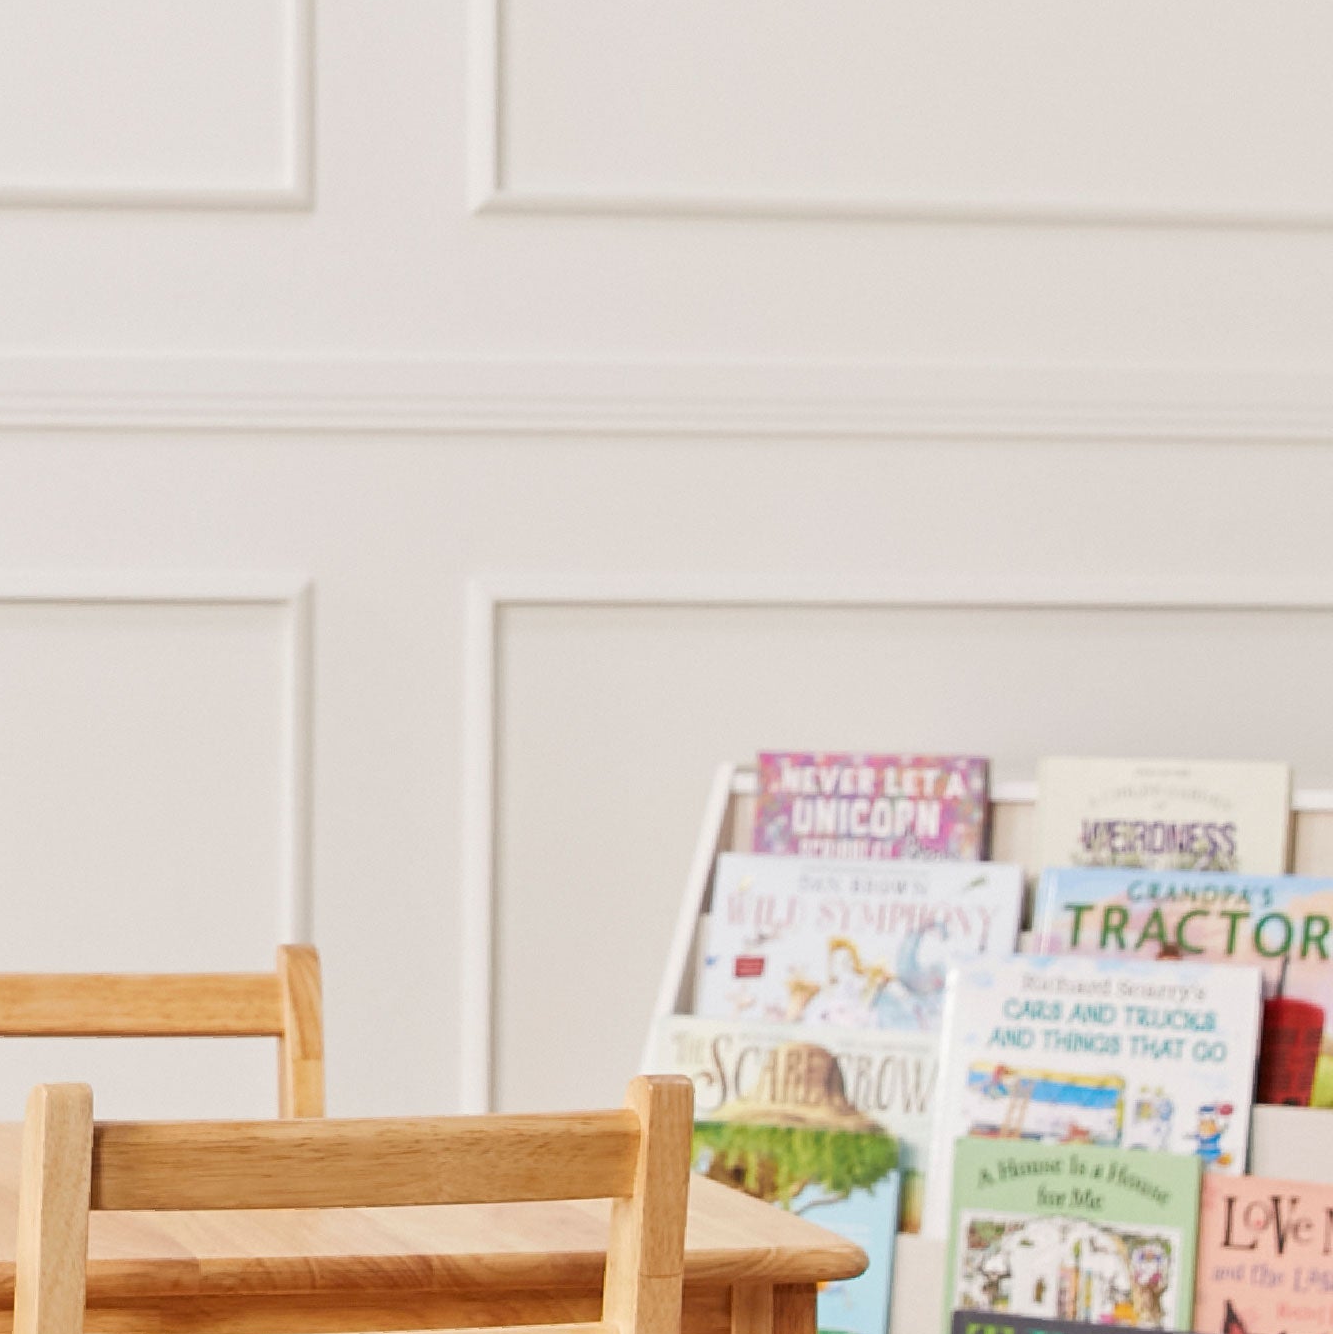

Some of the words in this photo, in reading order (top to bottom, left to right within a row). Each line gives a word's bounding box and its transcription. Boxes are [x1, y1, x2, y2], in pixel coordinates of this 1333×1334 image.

[782, 764, 875, 796] NEVER
[884, 765, 942, 797] LET
[944, 769, 967, 799] A
[791, 796, 941, 839] UNICORN
[1081, 818, 1238, 856] WEIRDNESS
[1127, 878, 1276, 908] GRANDPA'S
[1064, 901, 1333, 961] TRACTOR
[1002, 997, 1063, 1021] CARS
[1067, 1001, 1119, 1026] AND
[1123, 1005, 1219, 1033] TRUCKS
[988, 1025, 1036, 1050] AND
[1042, 1029, 1122, 1056] THINGS
[1130, 1035, 1189, 1060] THAT
[1191, 1038, 1229, 1064] GO
[997, 1155, 1062, 1181] House
[1106, 1160, 1171, 1206] House
[1037, 1182, 1067, 1208] for
[1069, 1186, 1103, 1211] Me
